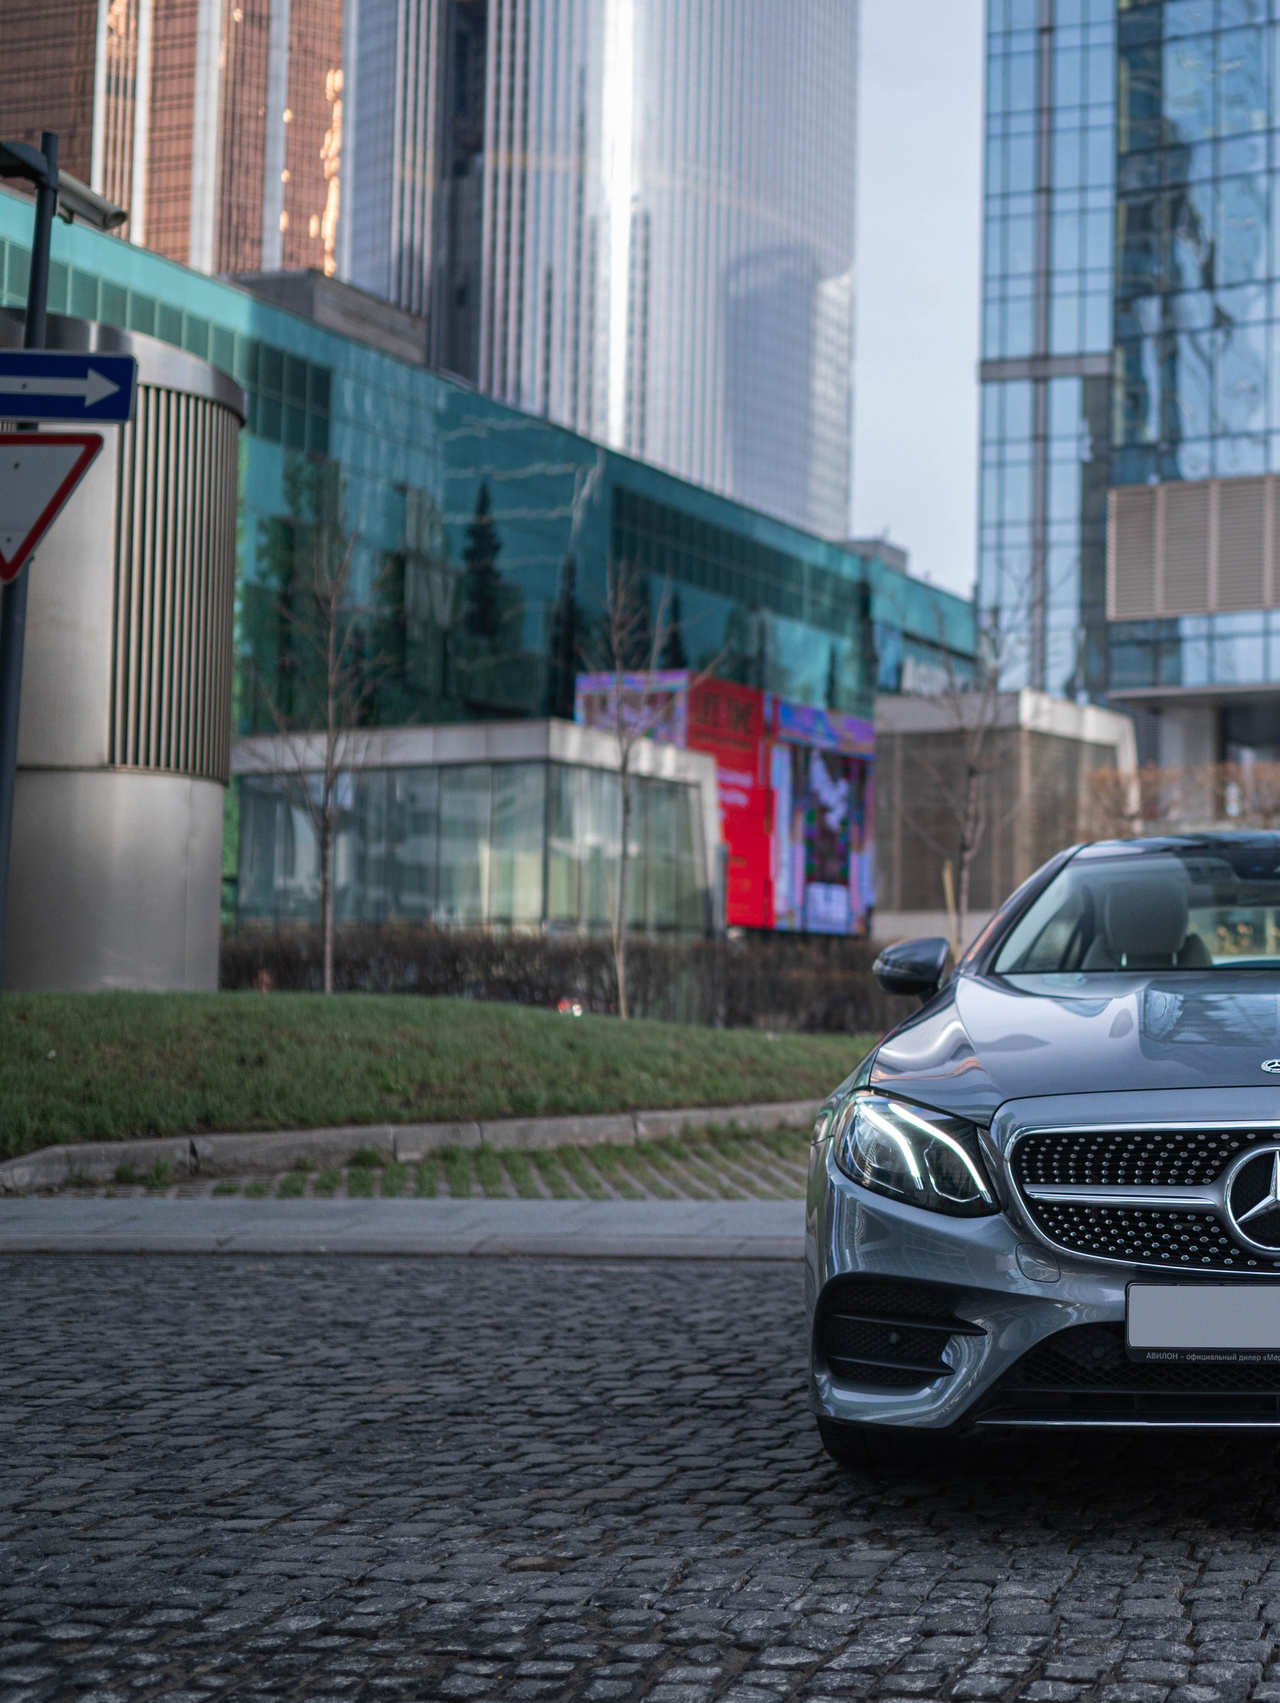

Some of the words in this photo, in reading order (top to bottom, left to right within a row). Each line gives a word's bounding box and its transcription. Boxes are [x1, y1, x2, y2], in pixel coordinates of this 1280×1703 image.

[1146, 1352, 1179, 1360] АВИЛОН
[1186, 1353, 1237, 1362] официальный
[1238, 1354, 1262, 1362] дилер
